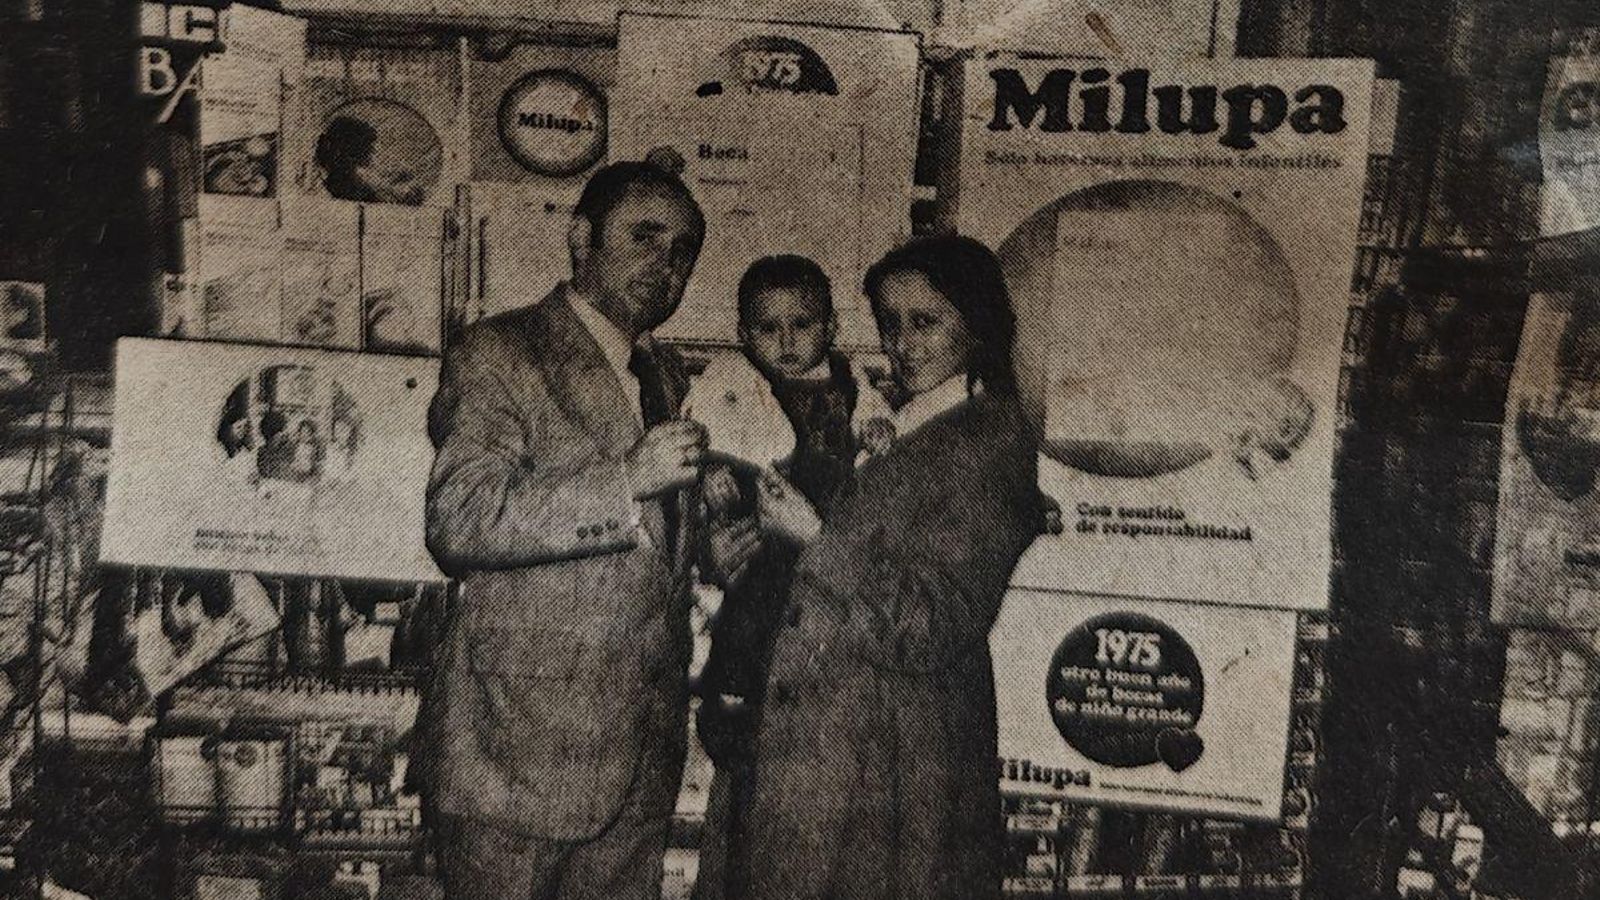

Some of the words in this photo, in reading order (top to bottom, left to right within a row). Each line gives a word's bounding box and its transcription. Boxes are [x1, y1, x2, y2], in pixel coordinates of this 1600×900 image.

[987, 67, 1348, 150] Milupa
[519, 112, 593, 134] Milupa
[1076, 502, 1113, 519] Con
[1117, 505, 1186, 521] sentido
[1076, 519, 1098, 535] de
[1101, 522, 1254, 542] responsabilidad
[1094, 628, 1162, 668] 1975
[1060, 665, 1101, 682] otro
[1104, 667, 1153, 686] buen
[1085, 683, 1108, 699] de
[1054, 695, 1077, 713] de
[999, 757, 1091, 791] ilupa
